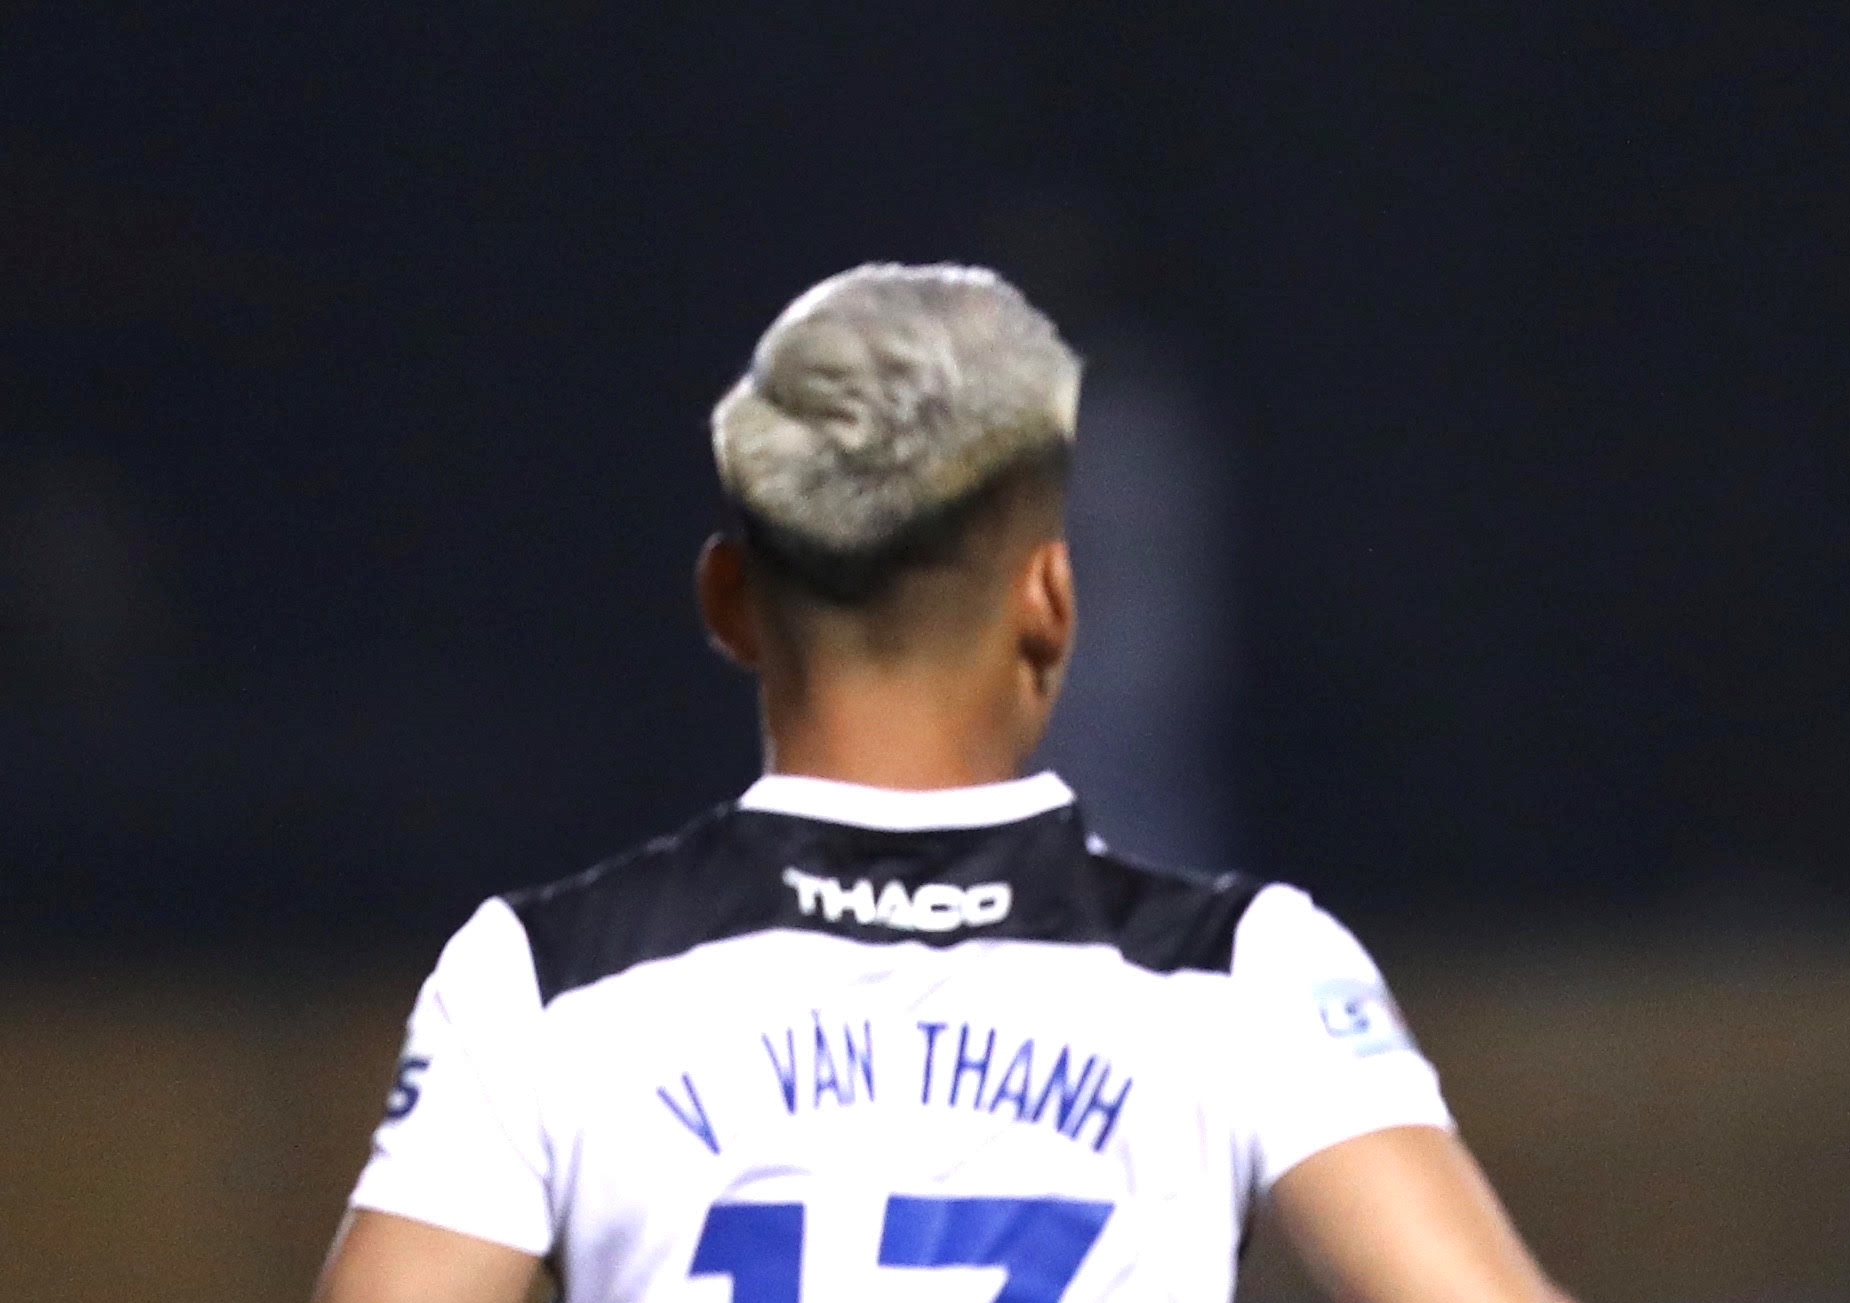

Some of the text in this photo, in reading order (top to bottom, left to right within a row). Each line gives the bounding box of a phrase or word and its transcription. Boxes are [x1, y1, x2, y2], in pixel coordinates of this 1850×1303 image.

[783, 867, 1011, 932] THACO
[656, 1071, 722, 1155] V
[915, 1021, 1134, 1153] THANH
